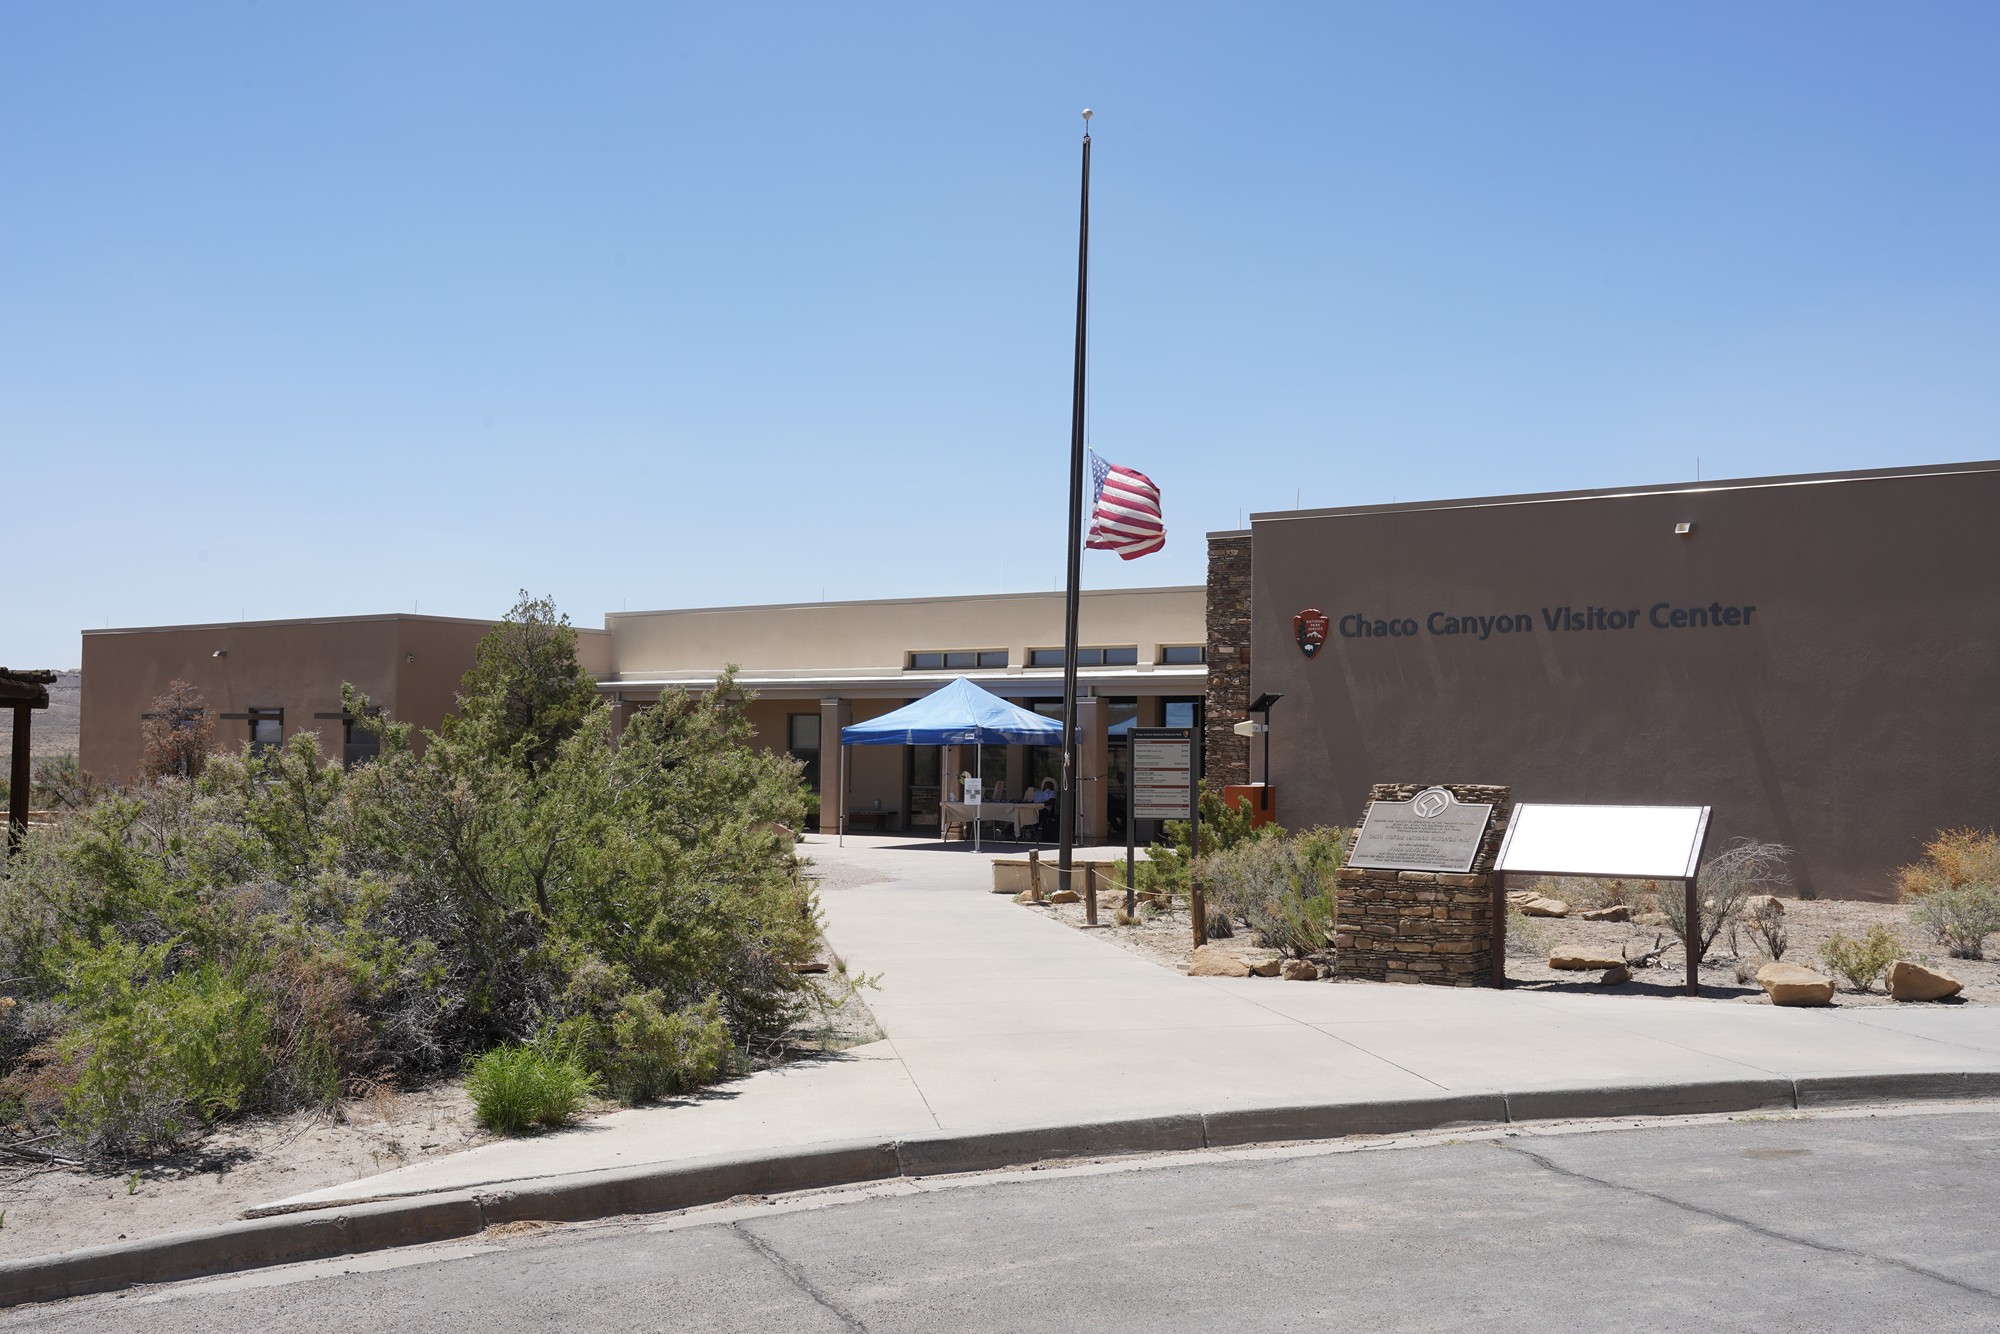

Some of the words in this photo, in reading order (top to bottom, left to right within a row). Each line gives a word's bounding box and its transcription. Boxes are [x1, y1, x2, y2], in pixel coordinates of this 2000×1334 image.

[1339, 613, 1418, 638] Chaco
[1427, 611, 1532, 640] Canyon
[1541, 606, 1640, 632] Visitor
[1650, 602, 1756, 628] Center
